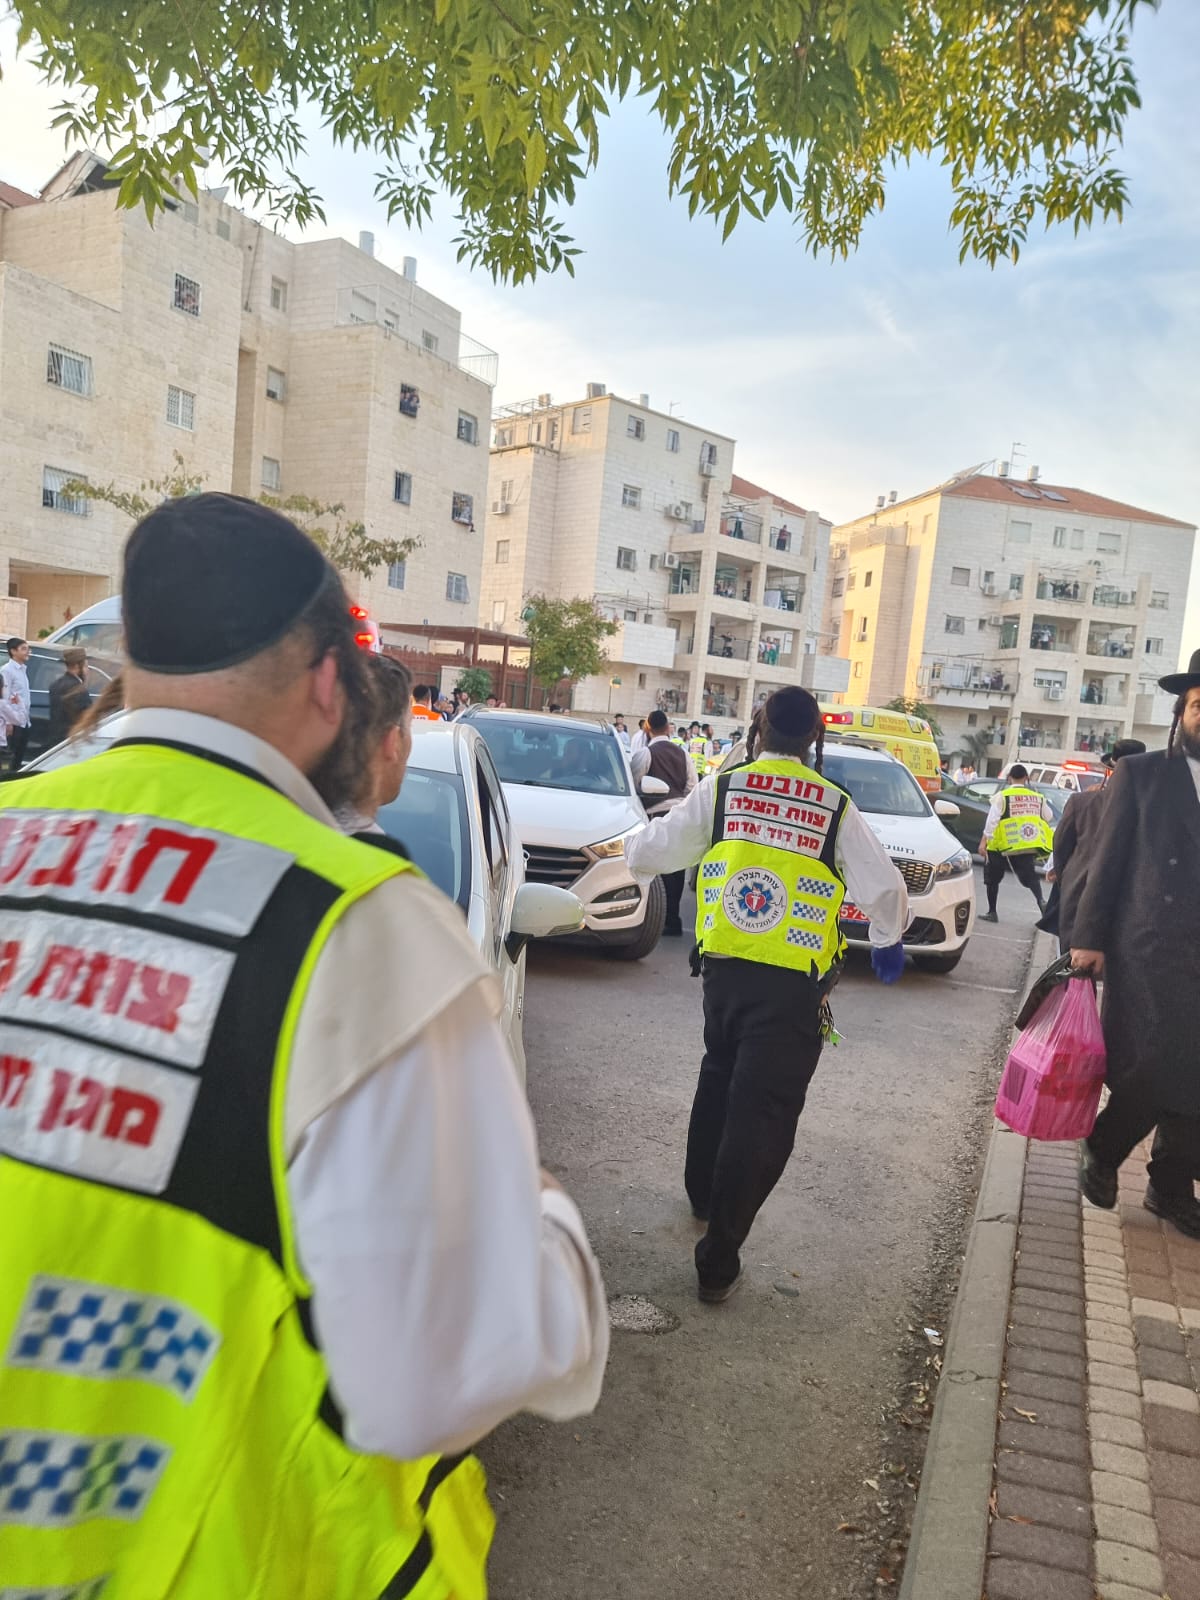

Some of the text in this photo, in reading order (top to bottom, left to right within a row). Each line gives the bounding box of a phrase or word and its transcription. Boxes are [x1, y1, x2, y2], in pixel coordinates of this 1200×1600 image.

[746, 773, 825, 802] חובש
[730, 796, 826, 828] צוות הצלה
[727, 821, 820, 850] מגן דוד אדום
[738, 871, 780, 890] צוות הצלה
[28, 945, 192, 1033] צוות
[37, 1070, 162, 1148] מגן
